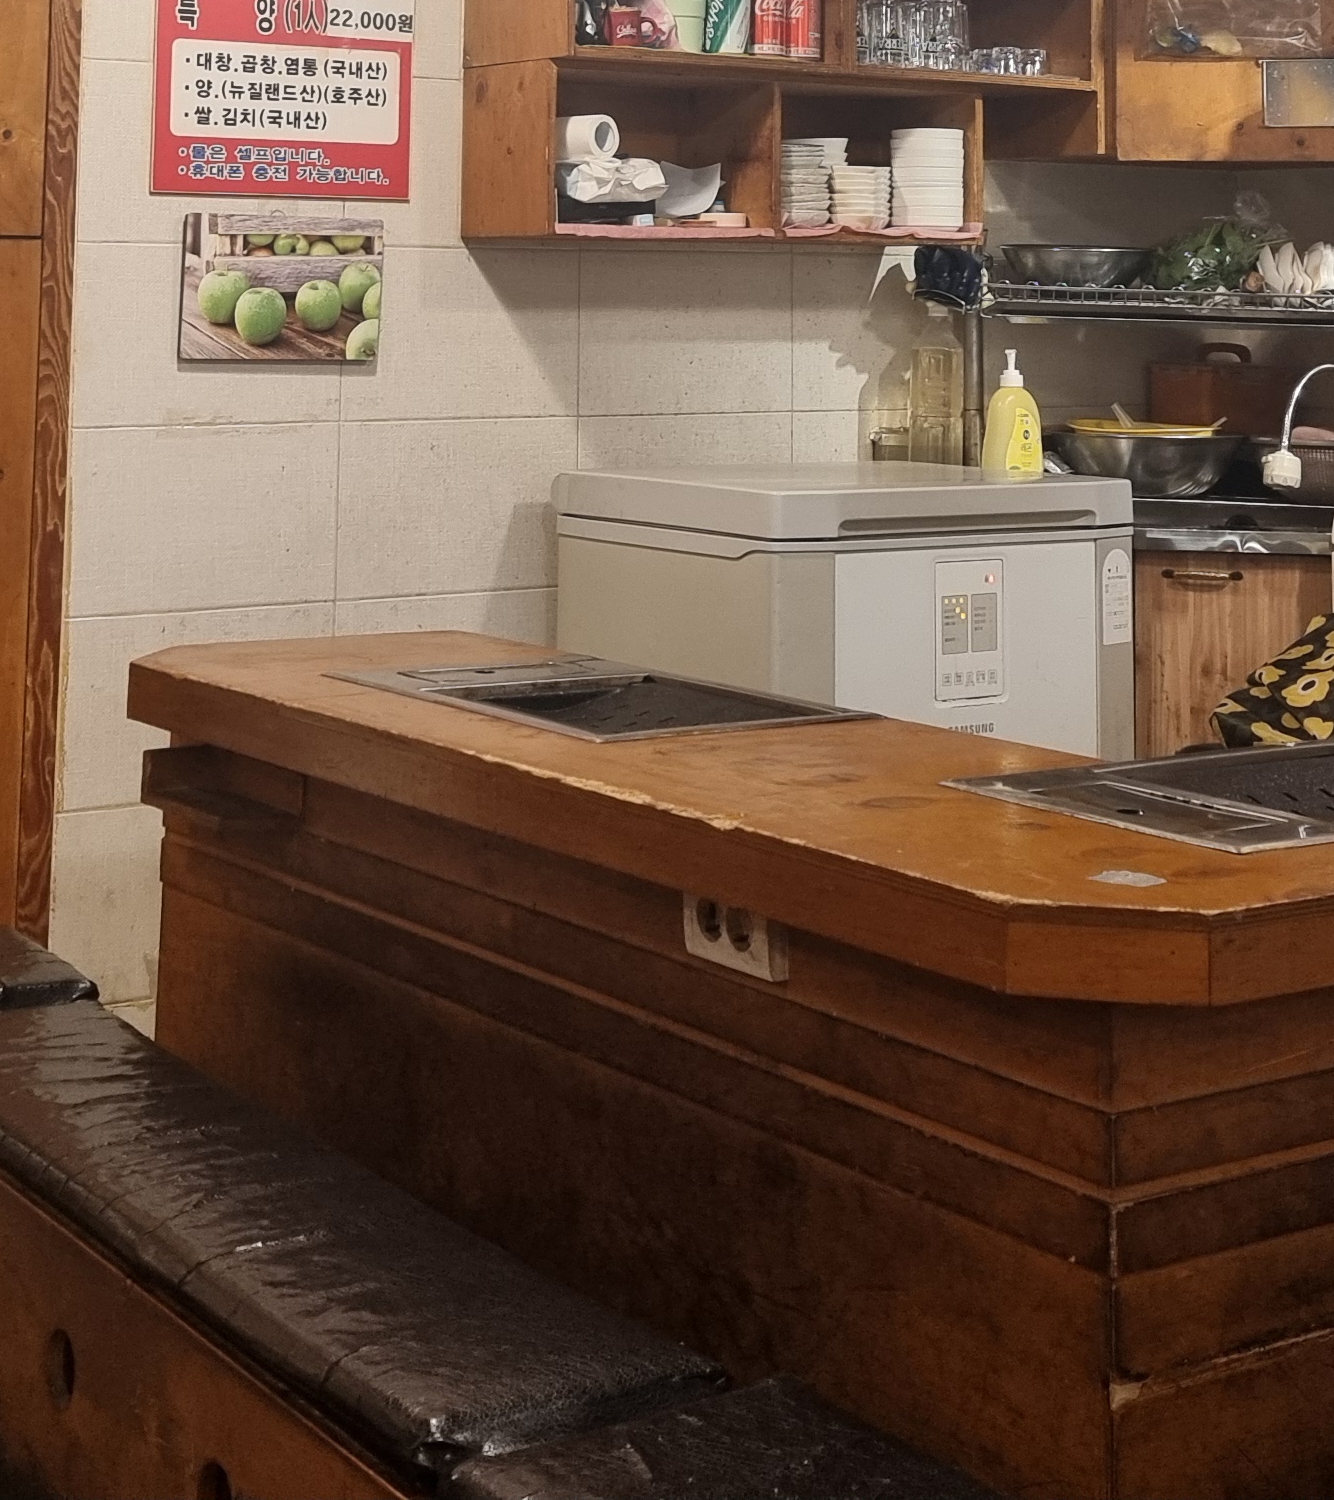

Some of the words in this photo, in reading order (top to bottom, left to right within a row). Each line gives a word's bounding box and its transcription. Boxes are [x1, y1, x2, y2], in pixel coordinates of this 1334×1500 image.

[329, 8, 414, 34] 22,000원
[323, 57, 388, 81] (국내산)
[235, 146, 331, 165] 셀프입니다.
[189, 162, 244, 179] 휴대폰
[253, 165, 289, 181] 충전
[296, 166, 390, 185] 가능합니다.
